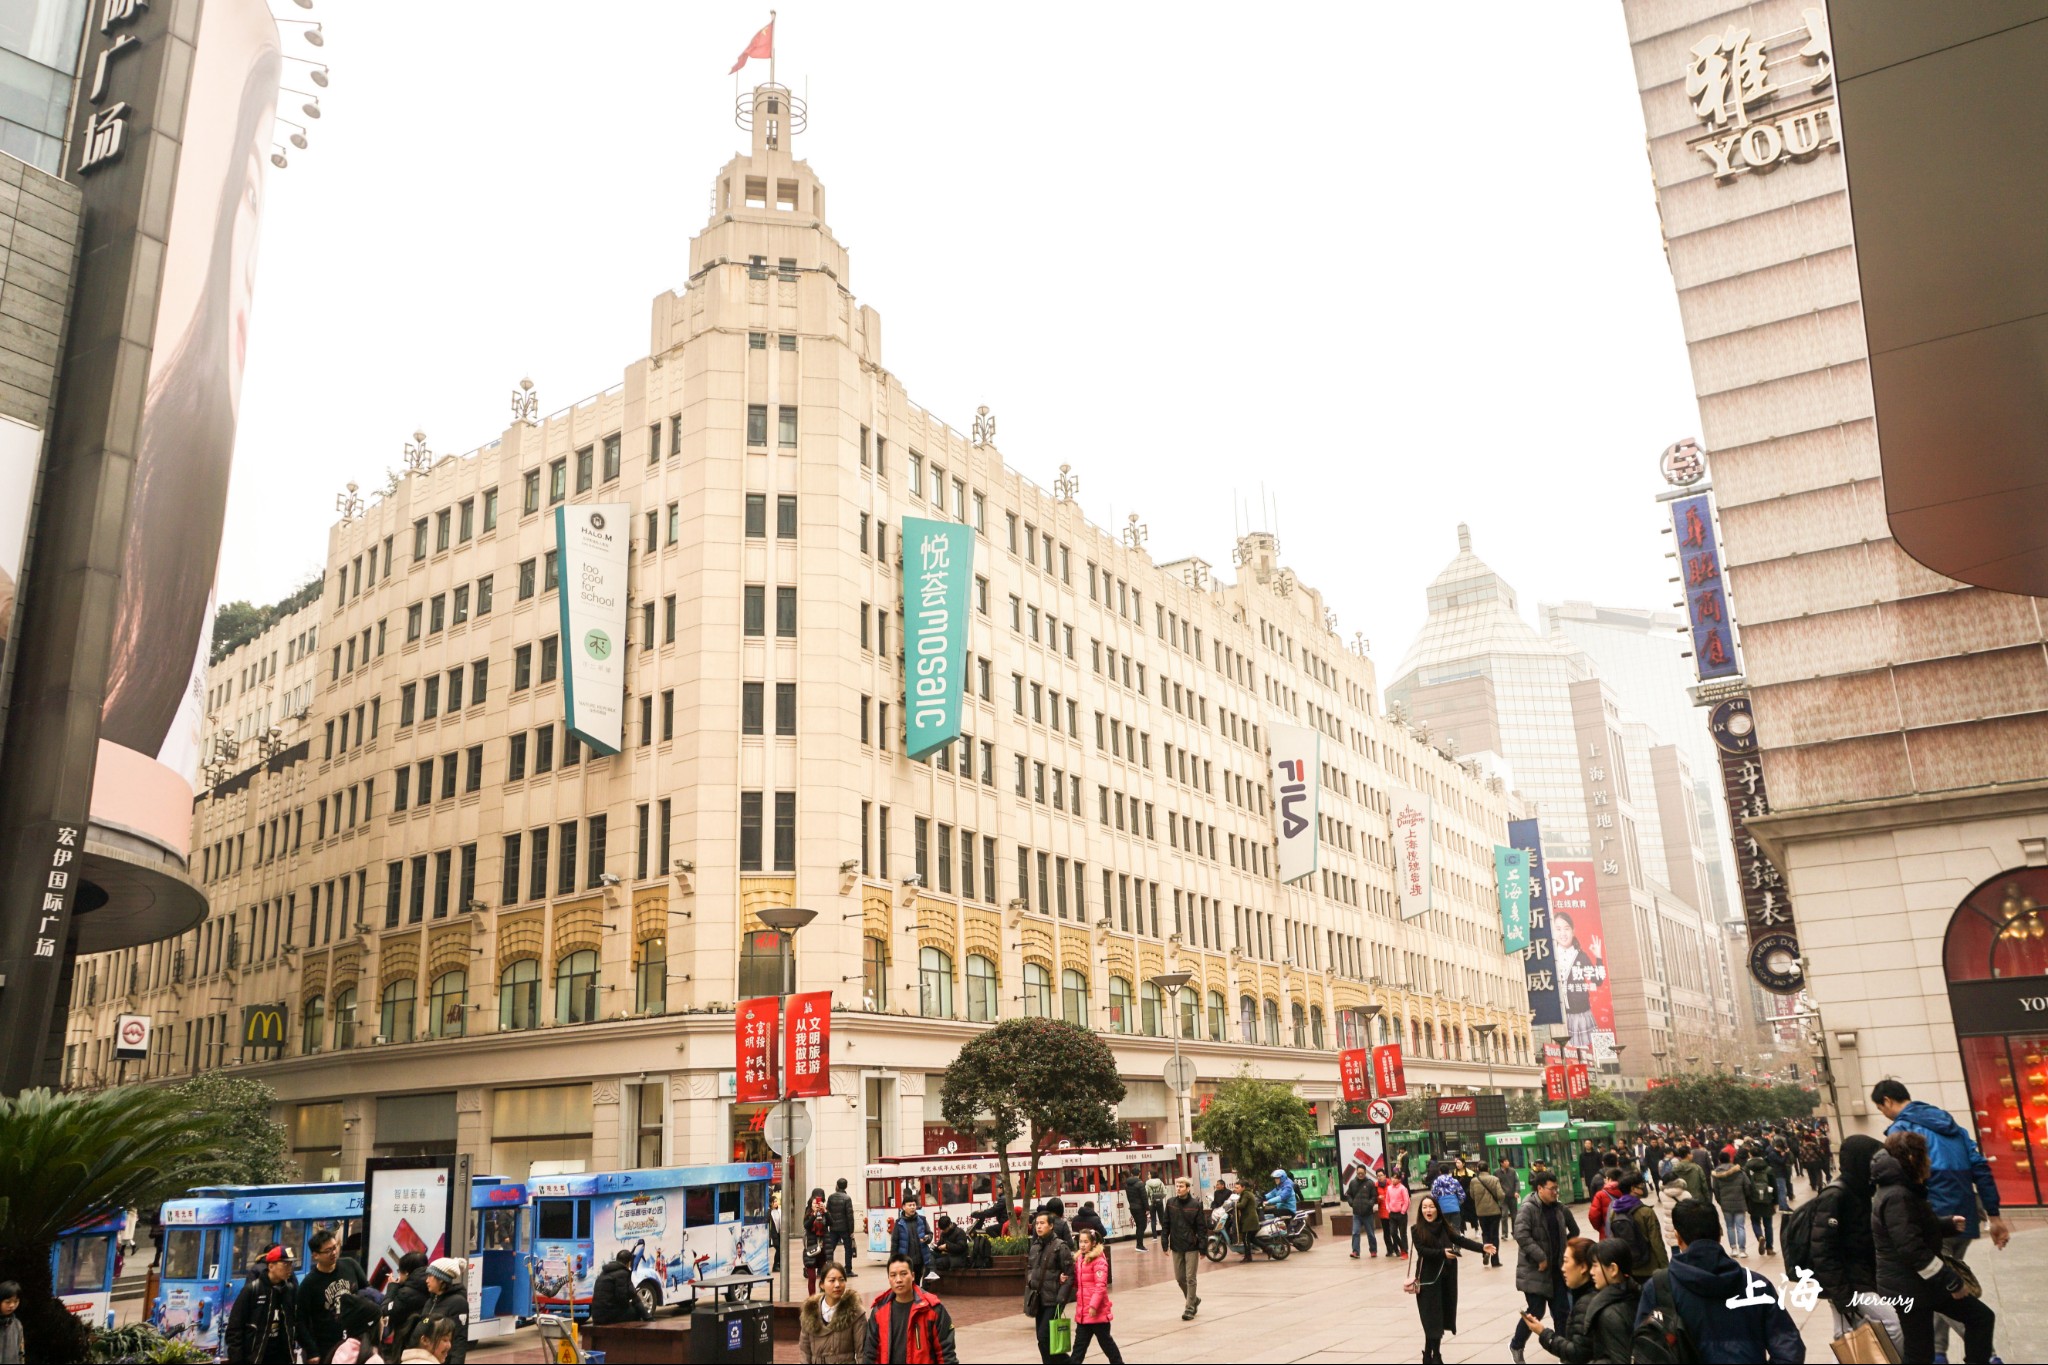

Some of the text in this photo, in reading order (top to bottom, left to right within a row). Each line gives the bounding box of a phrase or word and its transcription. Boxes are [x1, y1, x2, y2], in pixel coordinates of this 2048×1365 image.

[583, 562, 599, 575] too
[920, 533, 950, 608] 悦荟
[582, 572, 604, 585] cool
[581, 580, 595, 592] for
[580, 591, 615, 607] school
[1728, 701, 1745, 710] XII
[1713, 723, 1725, 732] IX
[1737, 739, 1750, 747] VI
[1278, 759, 1309, 839] FILA
[1588, 743, 1619, 875] 上海置地广场
[34, 827, 77, 957] 宏伊国际广场
[1780, 938, 1800, 954] DAL
[795, 1018, 807, 1075] 从我做起
[808, 1016, 821, 1074] 文明旅游
[1439, 1100, 1473, 1114] 可口可乐
[394, 1188, 426, 1199] 智慧新春
[393, 1203, 426, 1214] 年年有为
[210, 1266, 218, 1278] 7
